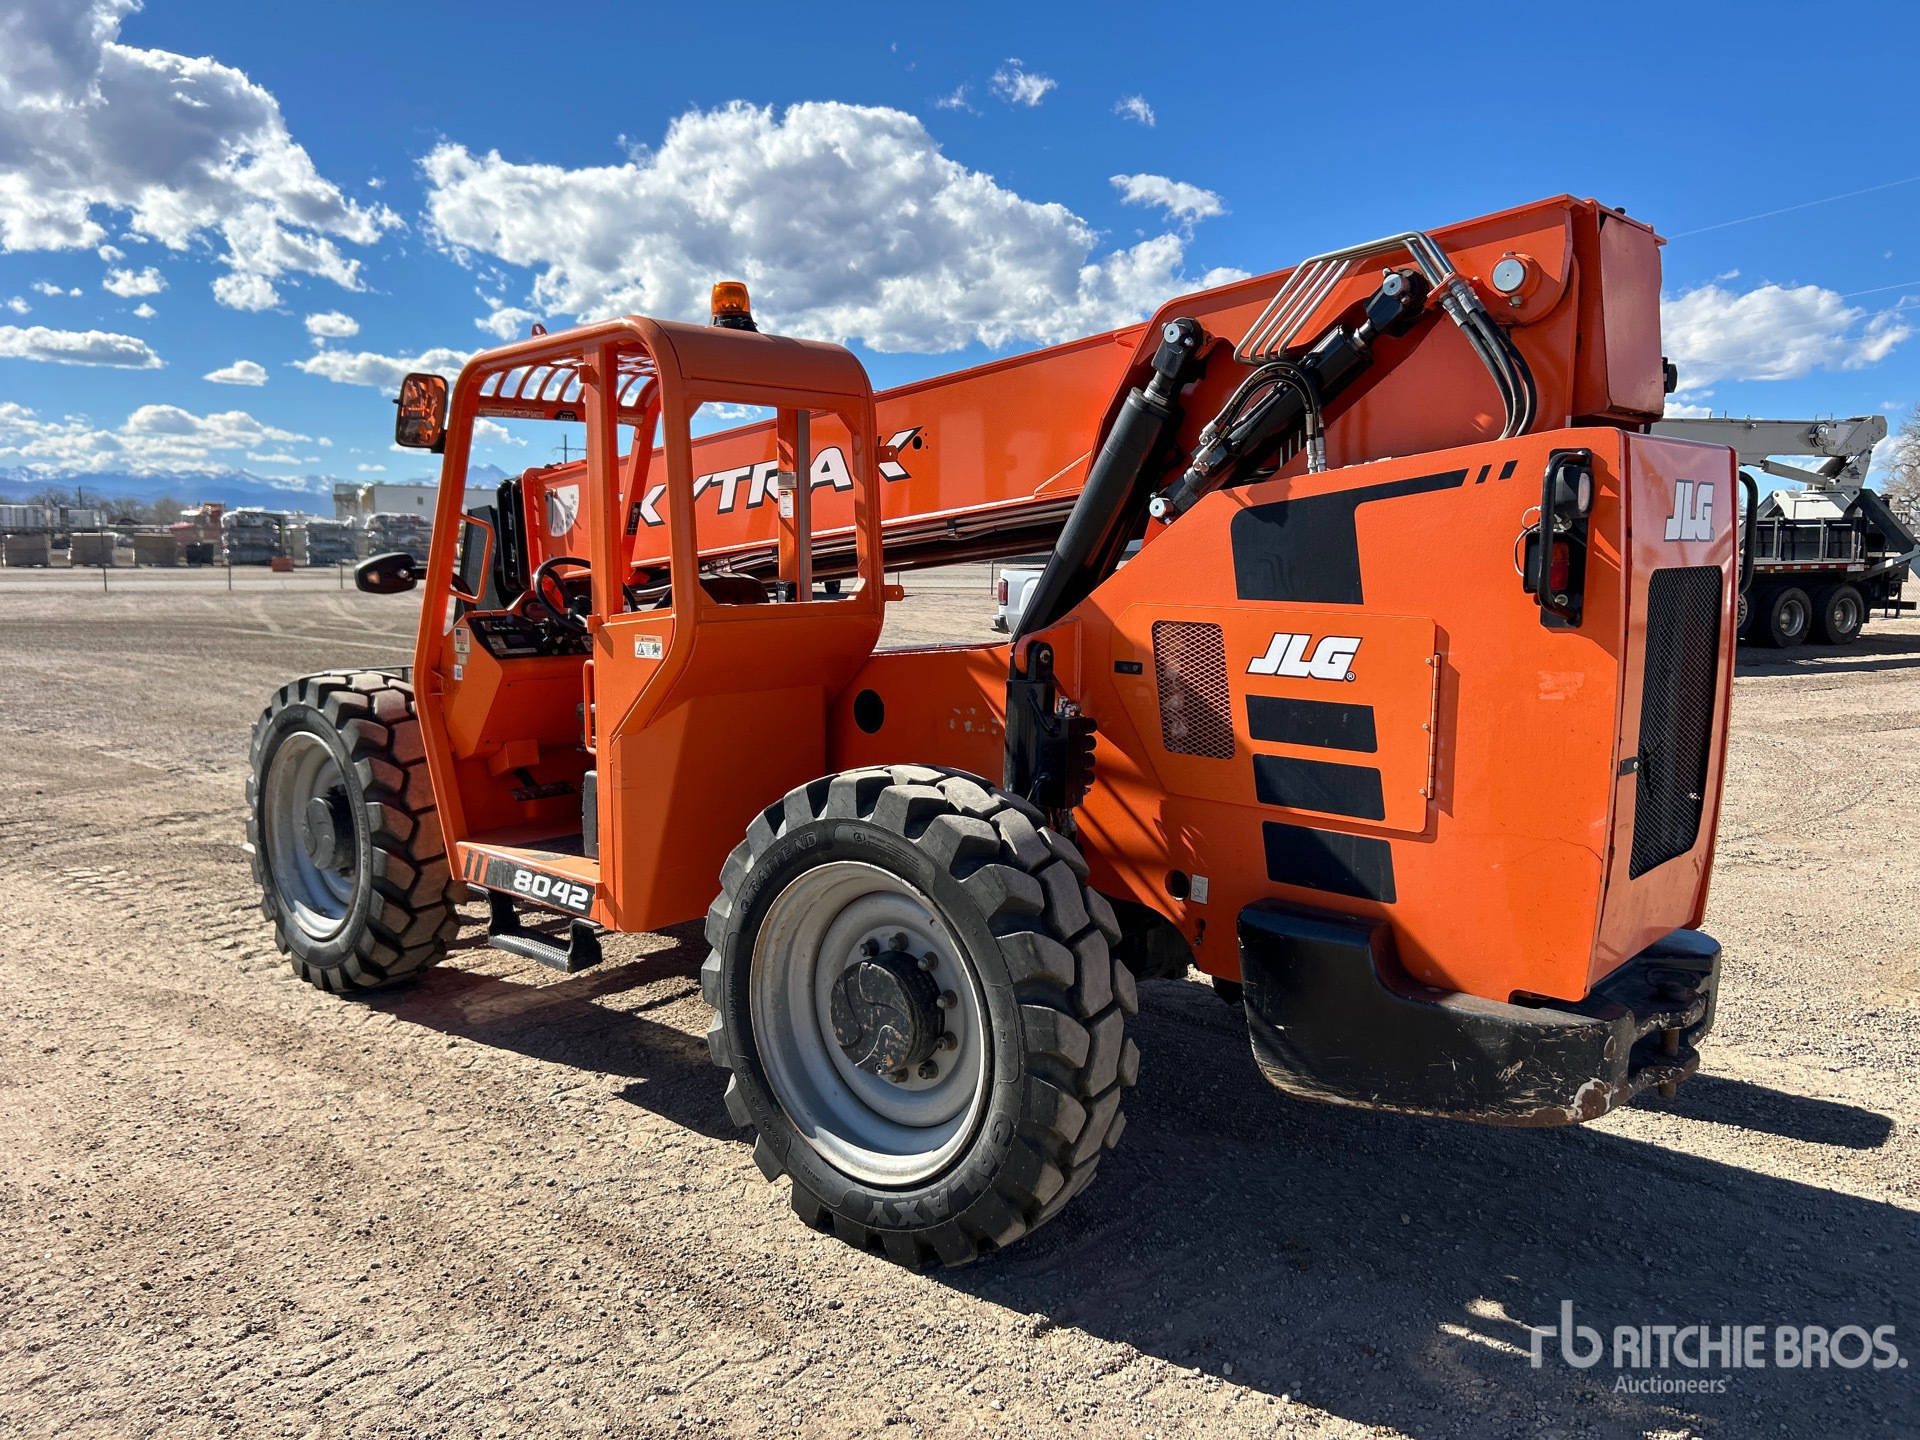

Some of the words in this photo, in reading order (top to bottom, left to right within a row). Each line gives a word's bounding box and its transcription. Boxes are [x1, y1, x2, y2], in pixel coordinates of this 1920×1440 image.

[1664, 479, 1714, 543] JLG
[1245, 631, 1363, 682] JLG
[513, 869, 589, 911] 8042
[740, 844, 792, 914] GIRAFFE
[793, 831, 817, 852] ND
[865, 1109, 1013, 1228] GALAXY
